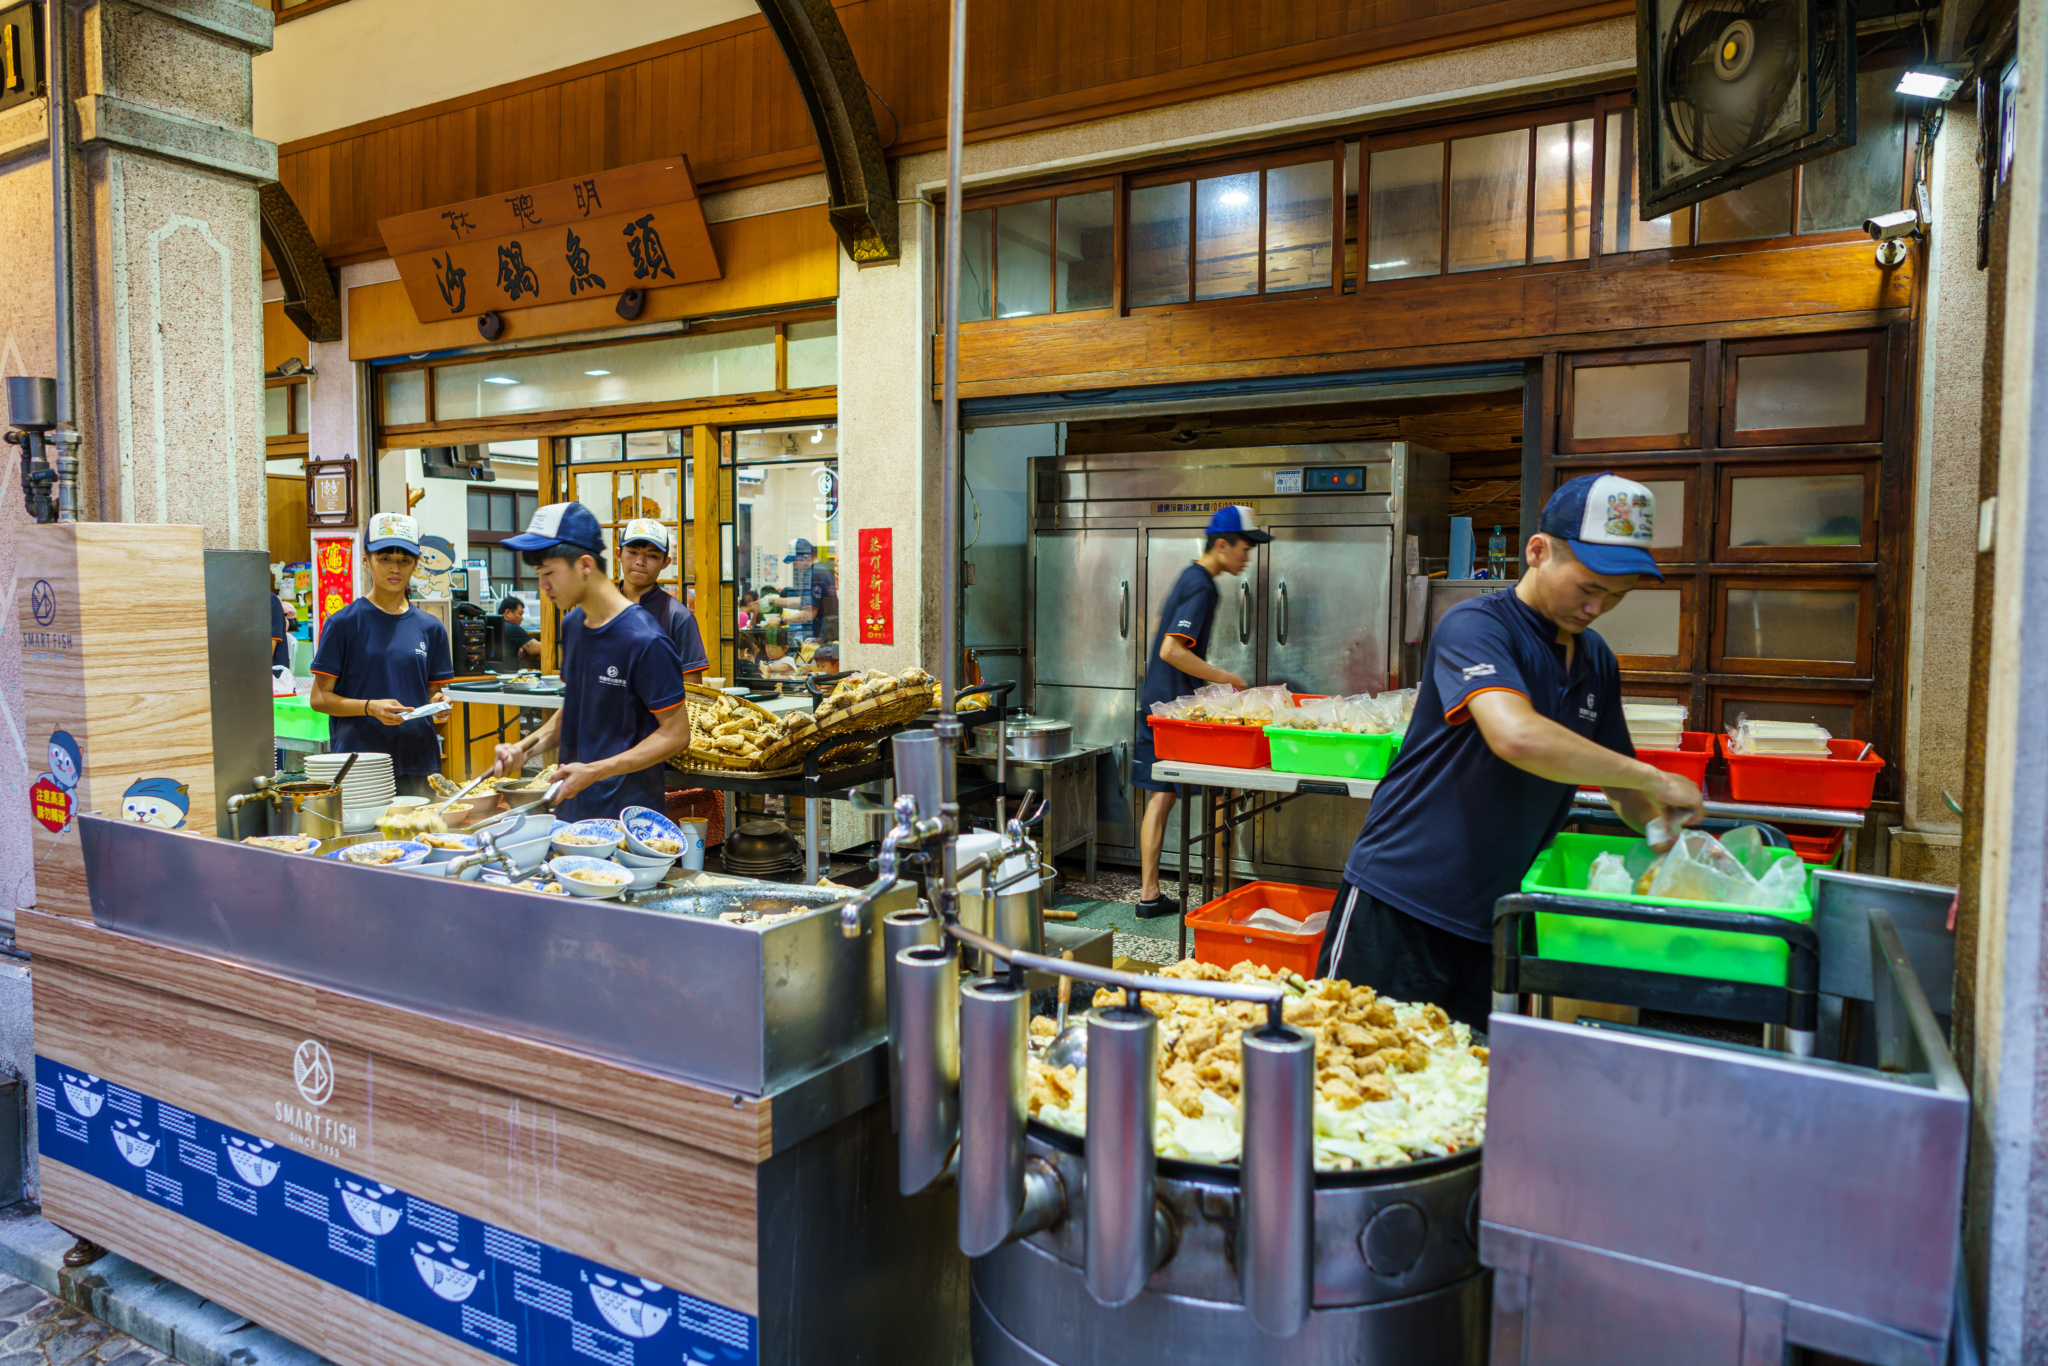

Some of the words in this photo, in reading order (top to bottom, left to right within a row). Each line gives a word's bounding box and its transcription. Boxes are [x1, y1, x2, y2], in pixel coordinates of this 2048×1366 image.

[441, 178, 602, 240] 林聰明
[431, 213, 676, 314] 沙鍋魚頭
[868, 536, 883, 610] 恭賀新禧
[23, 632, 50, 648] SMART
[53, 633, 73, 649] FISH
[36, 787, 66, 807] 注意高溫
[275, 1101, 321, 1136] SMART
[325, 1118, 357, 1149] FISH
[290, 1132, 316, 1149] SINCE
